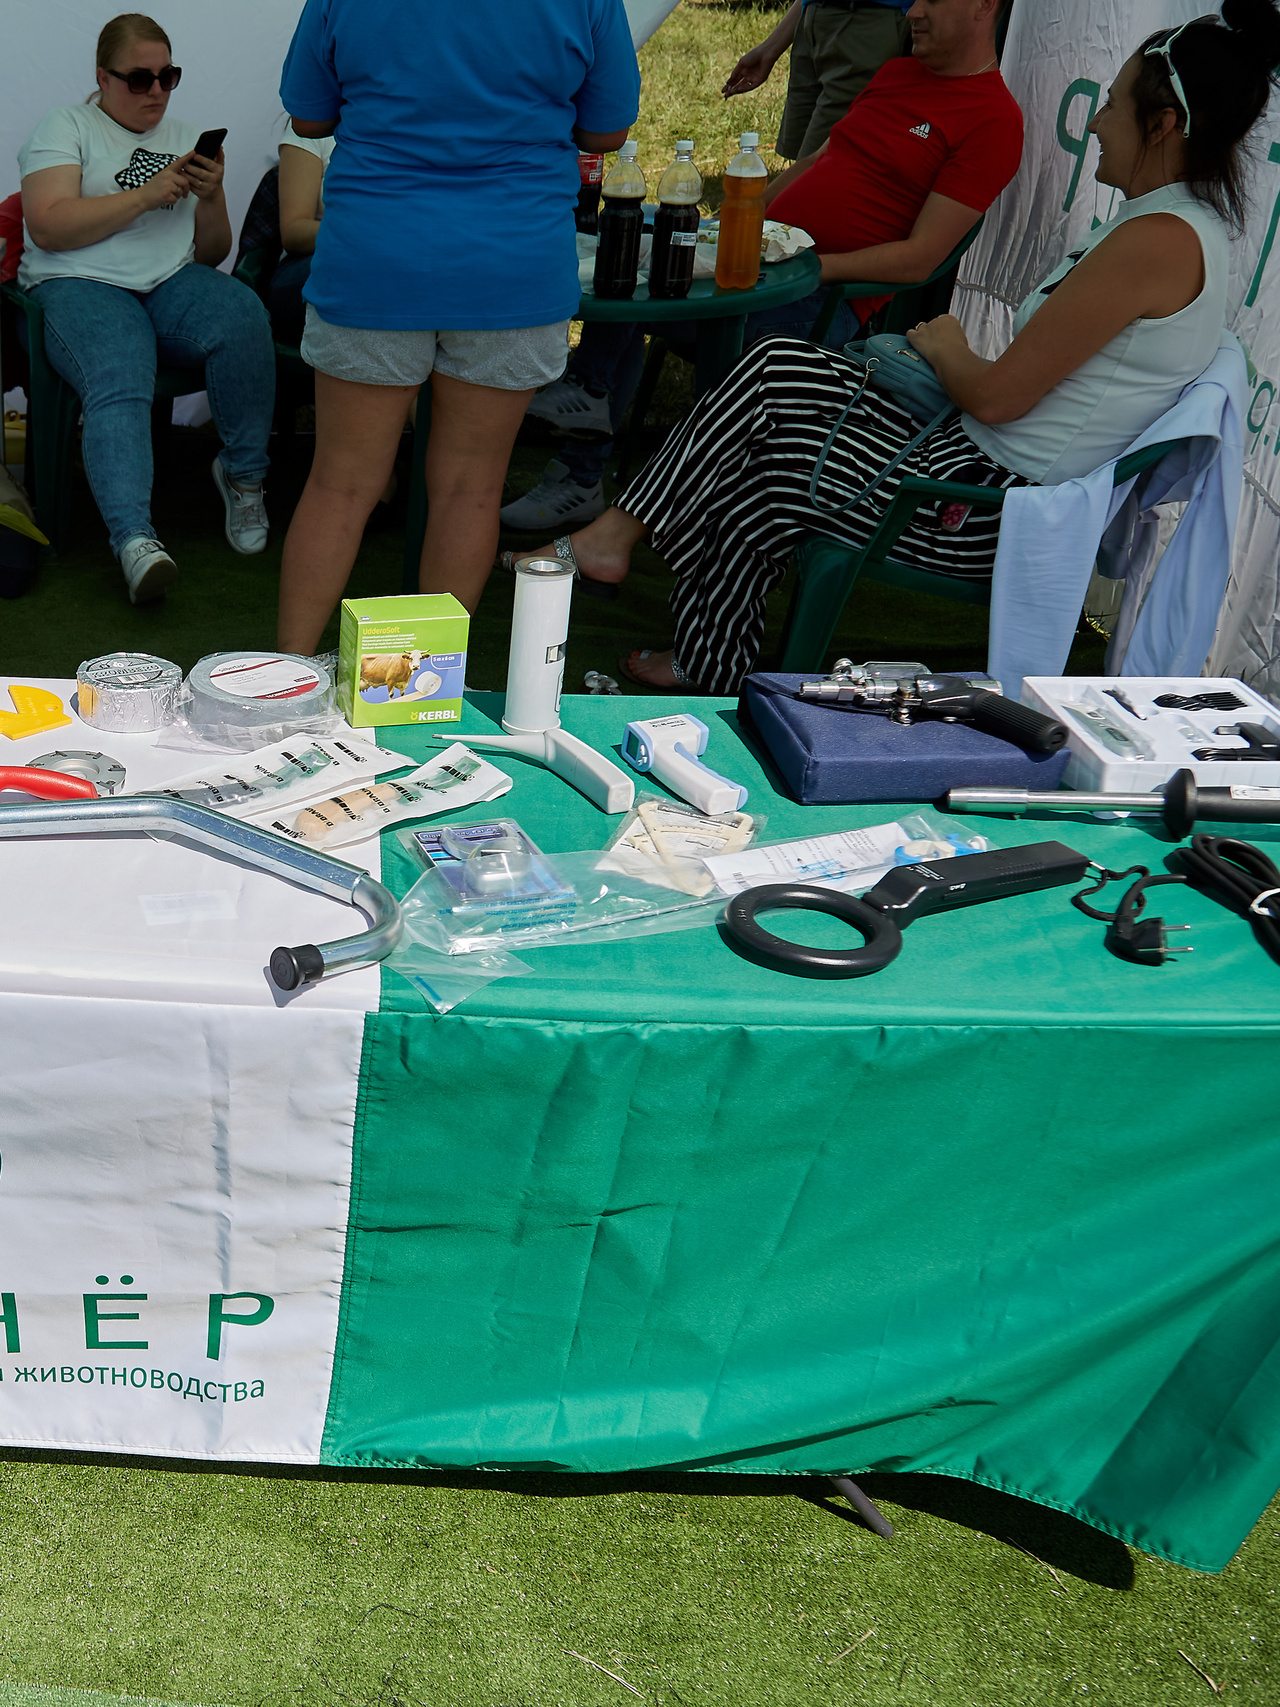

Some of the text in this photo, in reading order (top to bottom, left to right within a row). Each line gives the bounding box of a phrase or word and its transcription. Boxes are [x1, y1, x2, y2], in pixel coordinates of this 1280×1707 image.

[908, 127, 929, 139] adidas
[362, 626, 401, 635] UdderoSoft
[418, 709, 458, 721] KERBL
[14, 1365, 266, 1404] животноводства
